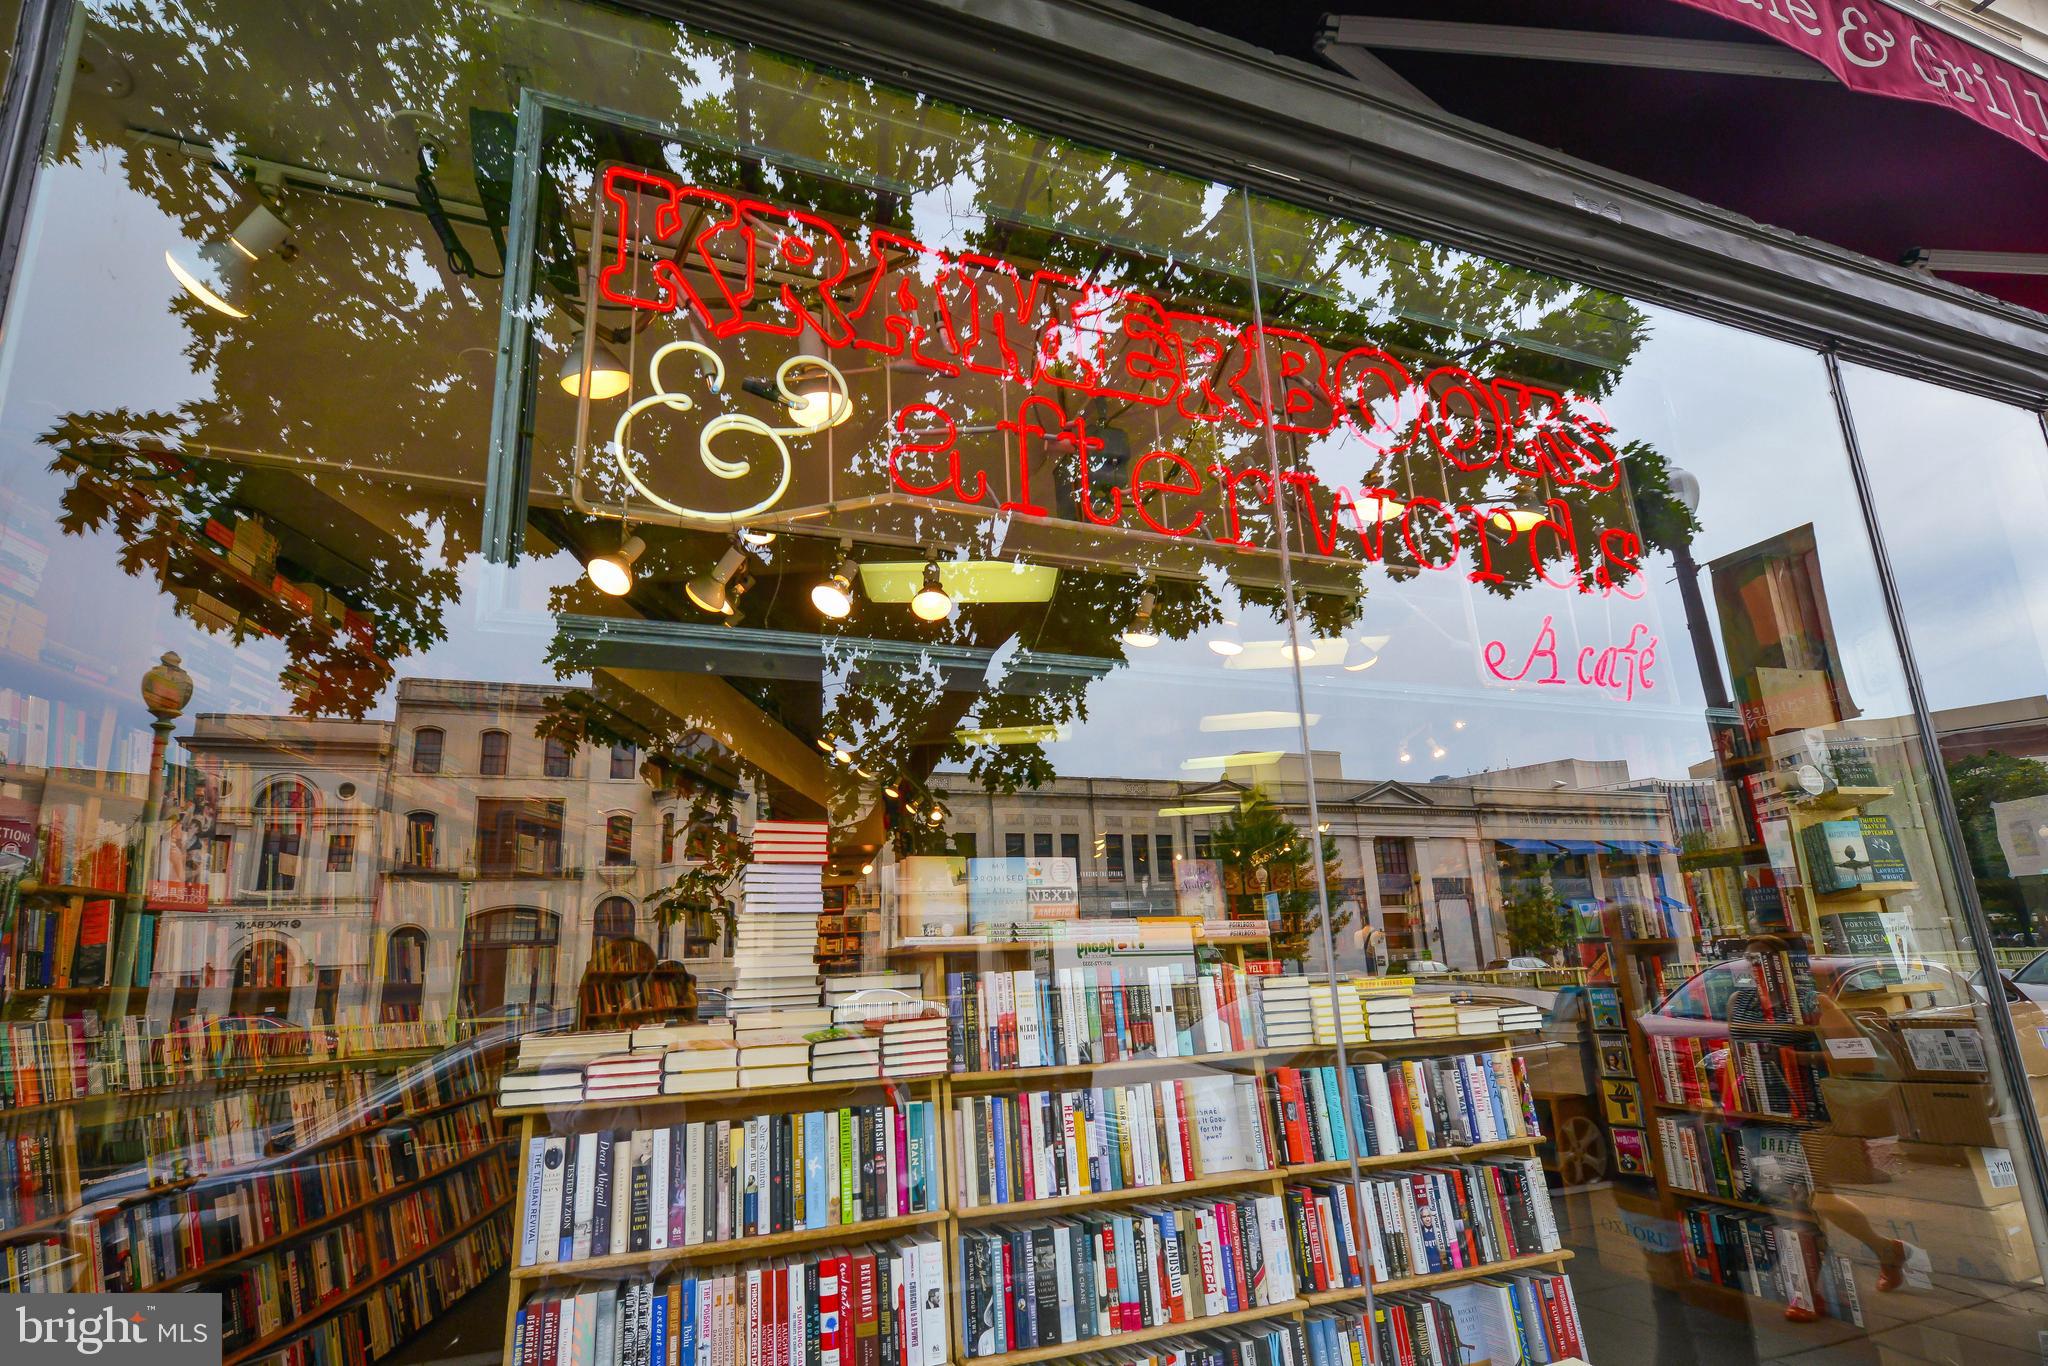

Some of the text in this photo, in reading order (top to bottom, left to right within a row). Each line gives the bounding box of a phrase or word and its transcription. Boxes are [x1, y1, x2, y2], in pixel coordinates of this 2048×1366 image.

[1837, 6, 1895, 68] &
[615, 340, 1648, 599] & afterwords
[1576, 622, 1658, 702] café
[0, 827, 31, 844] TIONS
[1029, 889, 1072, 901] NEXT
[1850, 934, 1887, 944] AFRICA
[1248, 965, 1263, 973] YELL
[1019, 1024, 1038, 1033] NIXON
[1454, 1071, 1467, 1113] CIVIL WAR
[1471, 1072, 1484, 1113] OUR AMERICA
[875, 1112, 884, 1152] UPRISING
[1064, 1105, 1074, 1138] HEART
[759, 1125, 768, 1188] Our Declaration
[911, 1139, 919, 1166] IRAN
[1994, 1160, 2013, 1174] Y101
[531, 1171, 540, 1206] TALIBAN
[596, 1140, 610, 1207] Dear Abigail
[564, 1163, 575, 1229] TESTED BY ZION
[1299, 1207, 1307, 1221] The
[1405, 1182, 1413, 1209] AMERICAN
[1428, 1187, 1437, 1211] finding
[1520, 1175, 1533, 1219] Alex's Wake
[528, 1208, 537, 1245] REVIVAL
[1230, 1210, 1238, 1233] Wendy
[1244, 1207, 1255, 1239] PAUL DE
[1309, 1213, 1317, 1230] LETHAL
[1338, 1189, 1354, 1254] Wilde America
[1026, 1241, 1036, 1297] INEVITABLE CITY
[1076, 1237, 1085, 1274] STEPHEN
[1167, 1239, 1182, 1295] LANDSLIDE
[1201, 1242, 1217, 1293] Attack
[861, 1263, 873, 1318] BEETHOVEN
[814, 1326, 819, 1335] TO
[1557, 1285, 1575, 1342] HIROSHIMA NAGASAKI
[524, 1315, 535, 1364] DEMOCRACY
[542, 1312, 553, 1361] DEMOCRACY
[683, 1325, 692, 1347] Poilu
